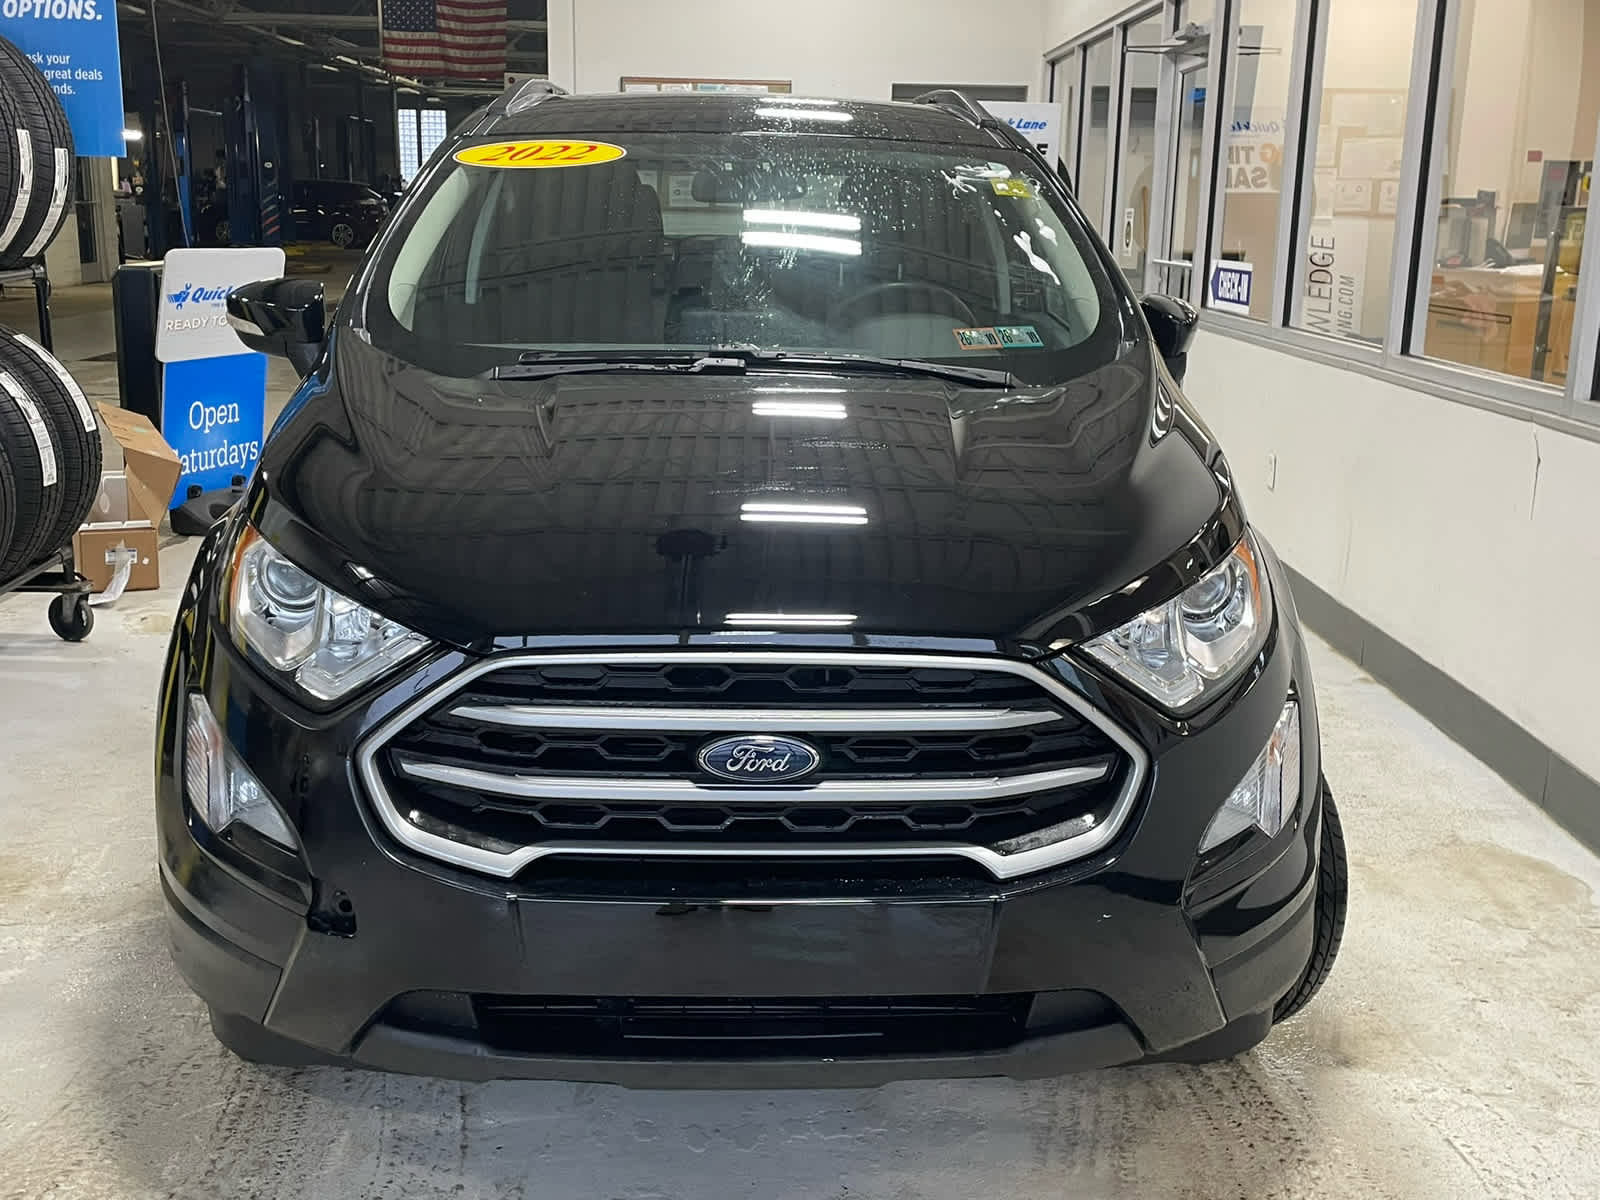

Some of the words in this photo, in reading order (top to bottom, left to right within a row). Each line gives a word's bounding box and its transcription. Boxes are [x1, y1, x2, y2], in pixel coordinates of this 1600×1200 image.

[2, 0, 103, 21] OPTIONS.
[46, 55, 71, 66] your
[43, 68, 72, 81] great
[74, 67, 103, 80] deals
[52, 83, 76, 95] nds.
[1015, 118, 1048, 130] Lane
[479, 145, 598, 162] 2022
[166, 316, 209, 331] READY
[188, 400, 240, 434] Open
[173, 439, 259, 476] aturdays
[726, 744, 791, 772] Ford
